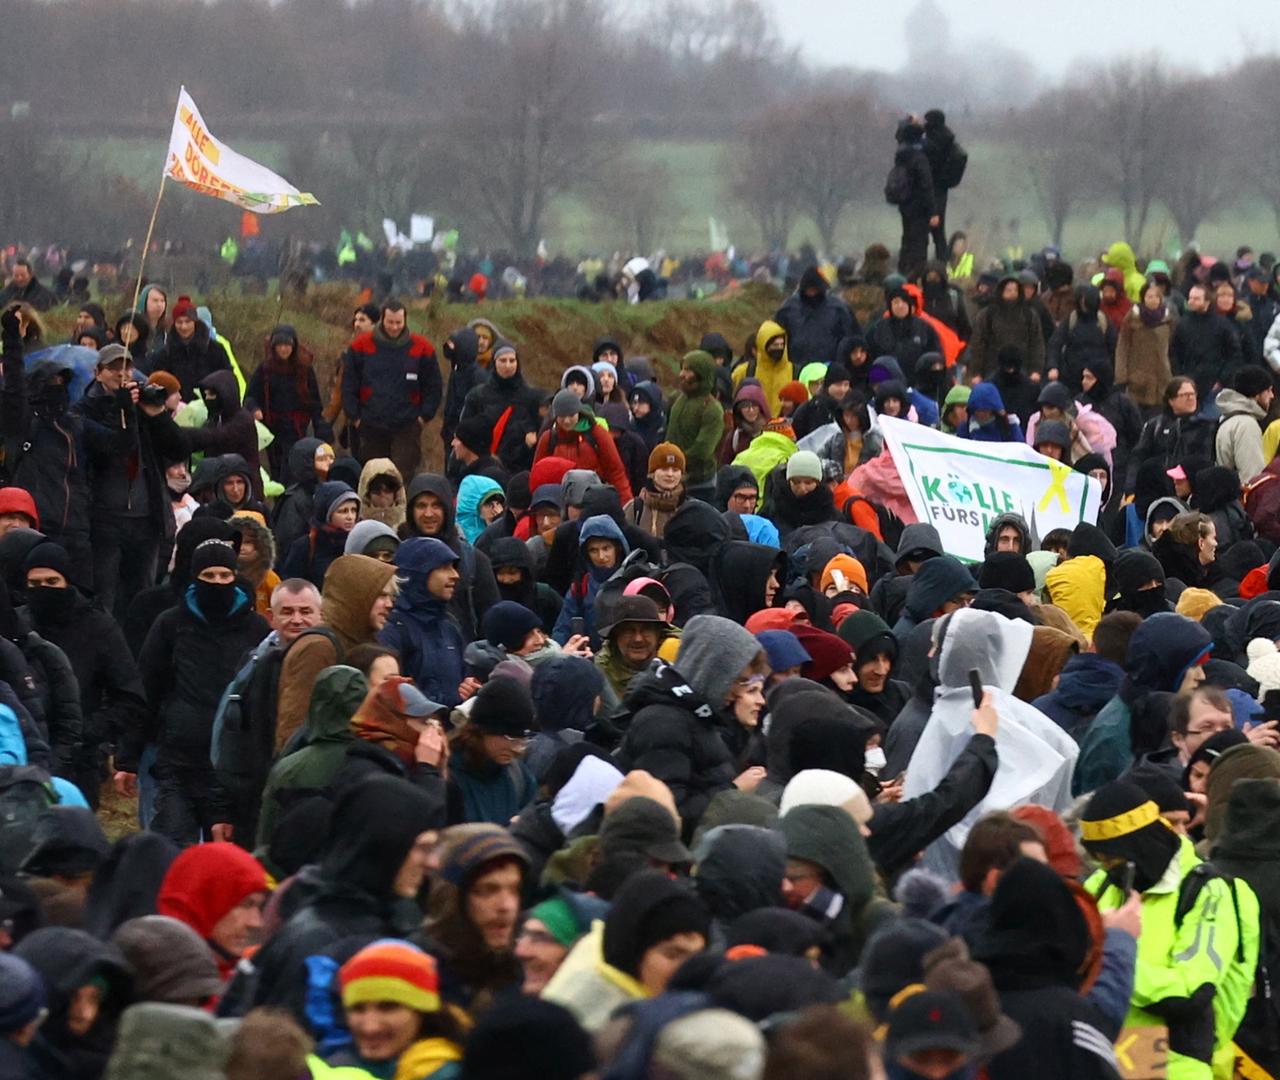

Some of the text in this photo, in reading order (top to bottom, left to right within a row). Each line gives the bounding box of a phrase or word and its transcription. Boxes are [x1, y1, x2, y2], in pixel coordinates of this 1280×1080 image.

[186, 113, 209, 153] ALLE
[922, 473, 1014, 513] KÖLLE
[931, 503, 980, 527] FÜRS
